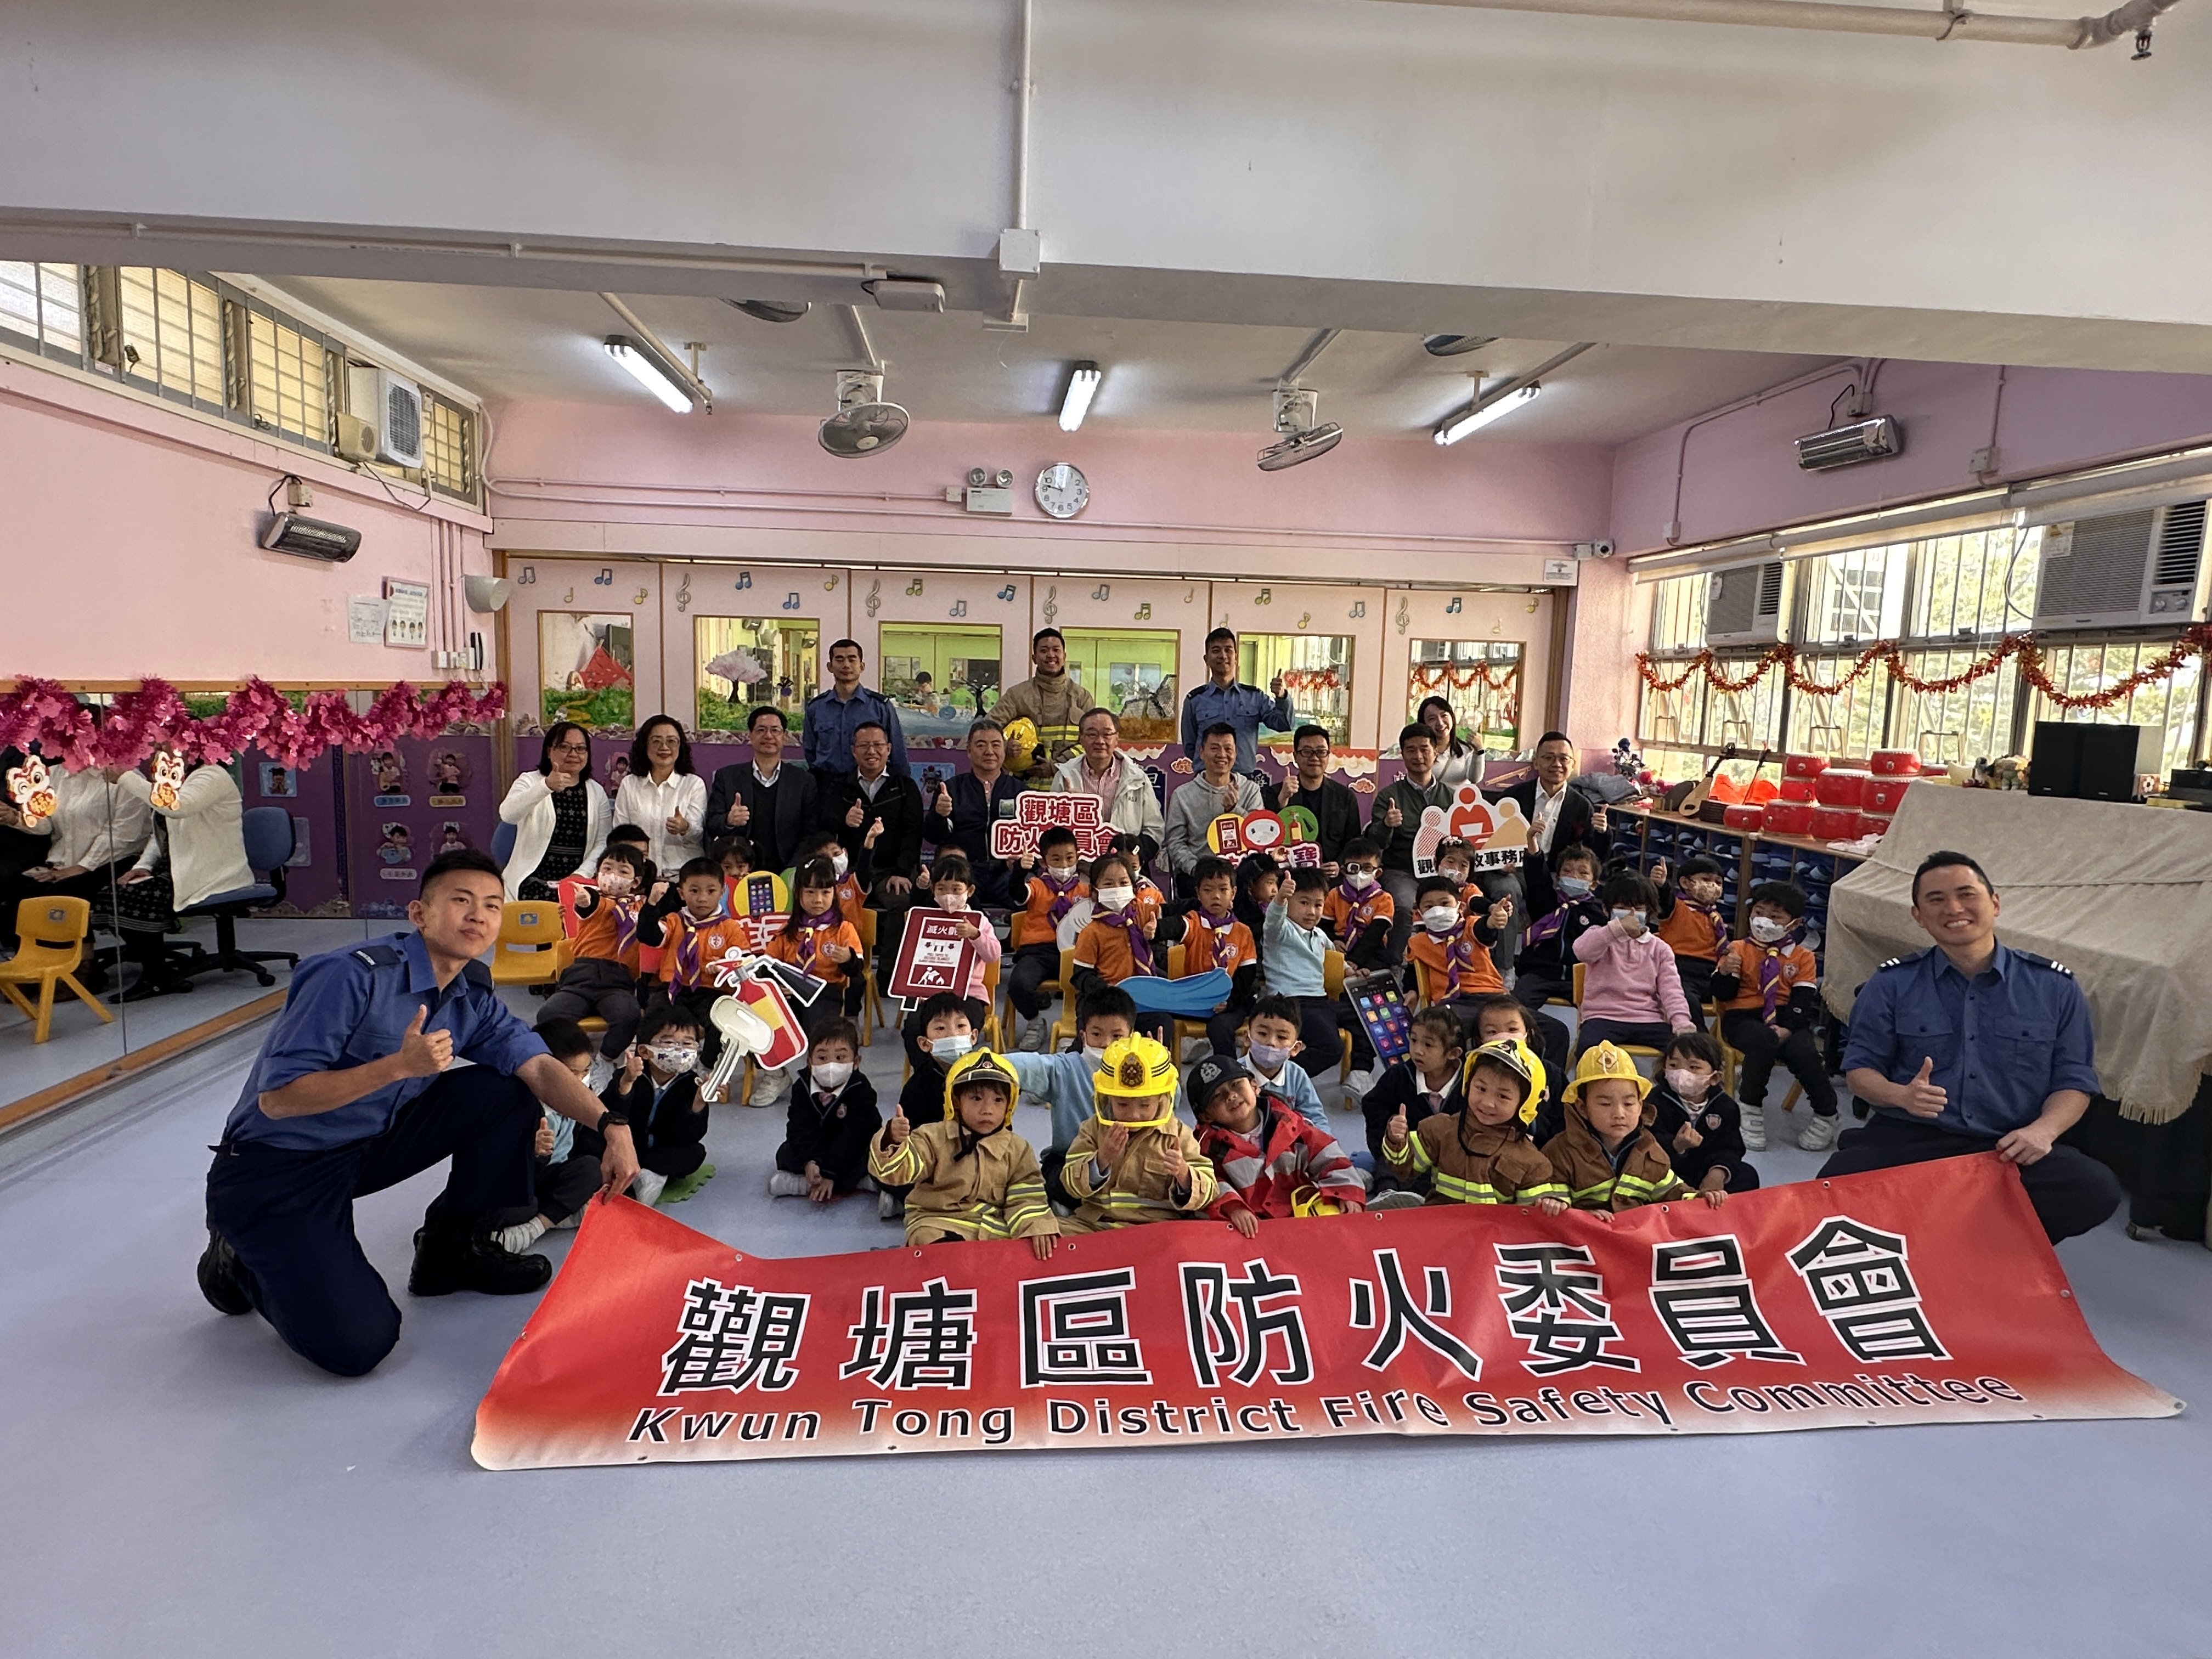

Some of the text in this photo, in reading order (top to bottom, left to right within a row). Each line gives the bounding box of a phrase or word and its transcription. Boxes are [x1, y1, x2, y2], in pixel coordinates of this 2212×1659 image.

[1024, 798, 1095, 824] 觀塘區
[998, 826, 1119, 854] 防火員會
[656, 1215, 1954, 1397] 觀塘區防火委員會
[626, 1372, 2026, 1445] Kwun Tong District Fire Safety Committee
